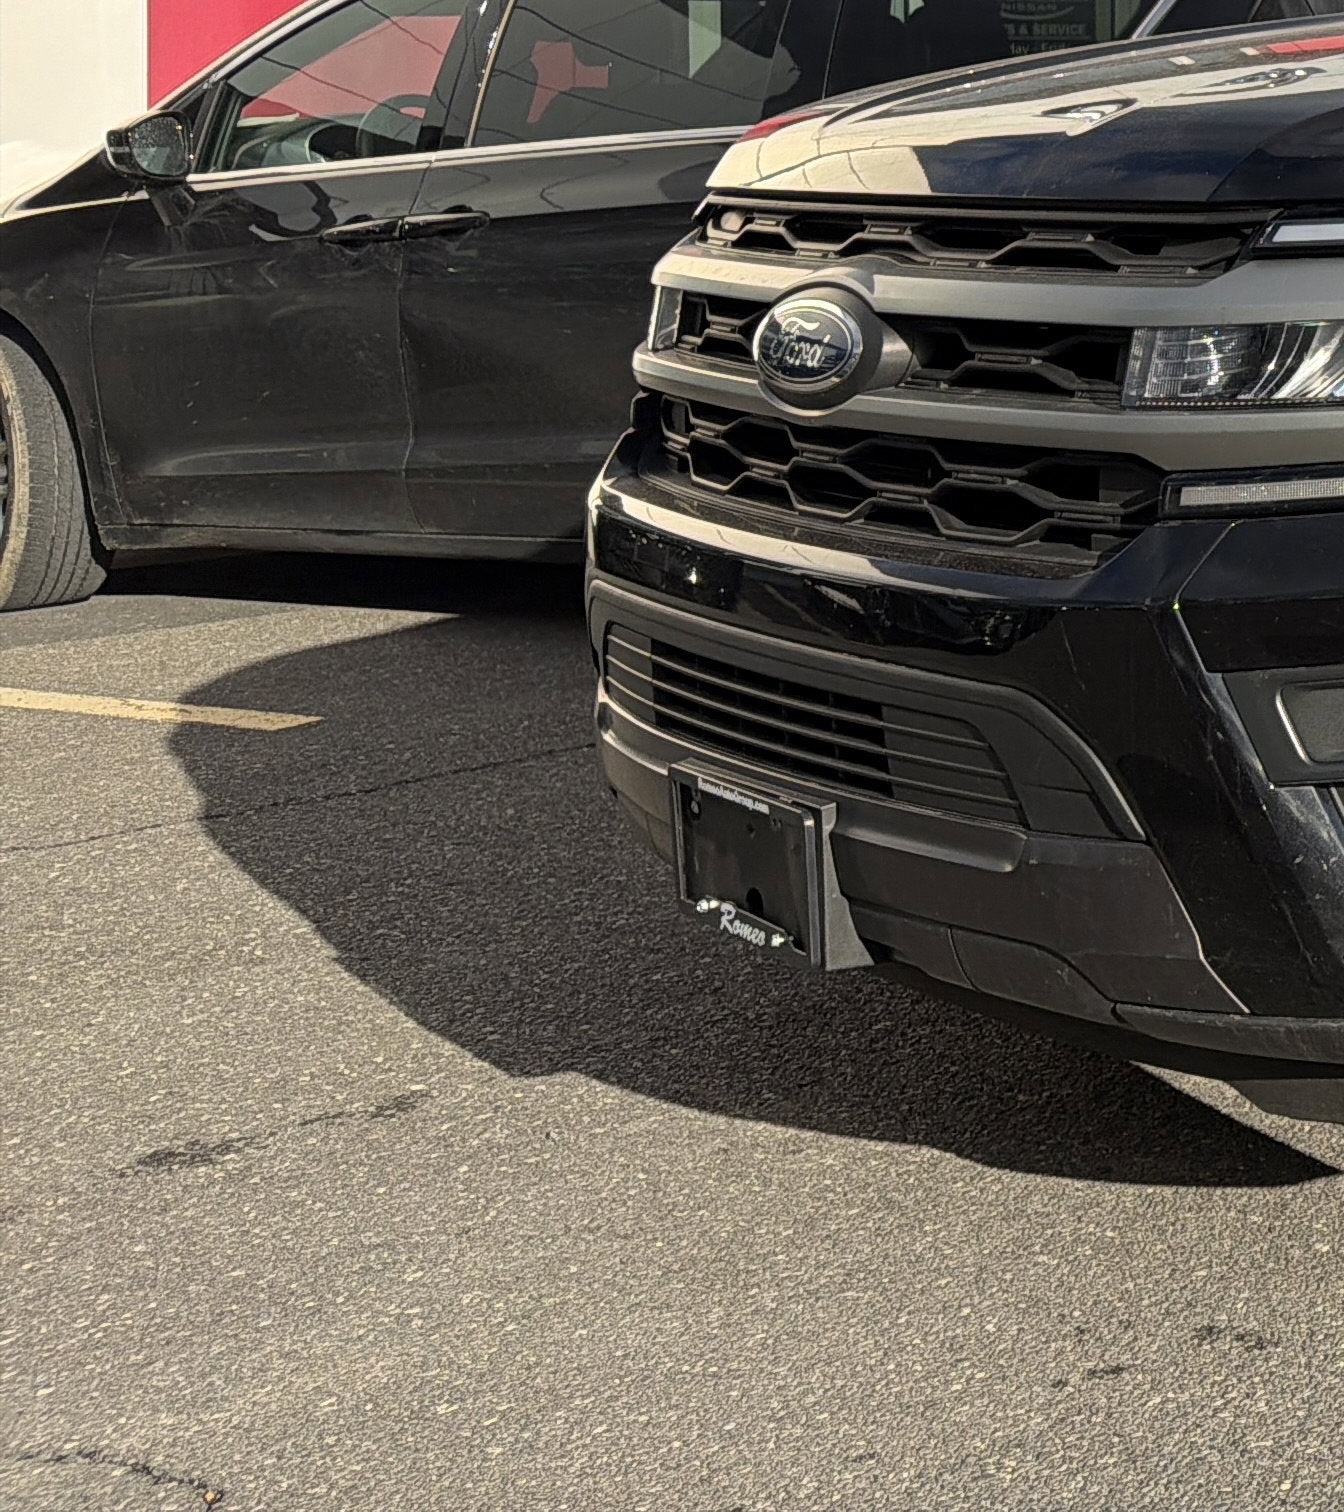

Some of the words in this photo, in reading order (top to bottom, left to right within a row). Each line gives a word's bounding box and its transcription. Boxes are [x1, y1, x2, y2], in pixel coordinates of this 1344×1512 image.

[1033, 22, 1086, 35] SERVICE
[769, 316, 832, 369] Ford
[719, 901, 766, 947] Romeo
